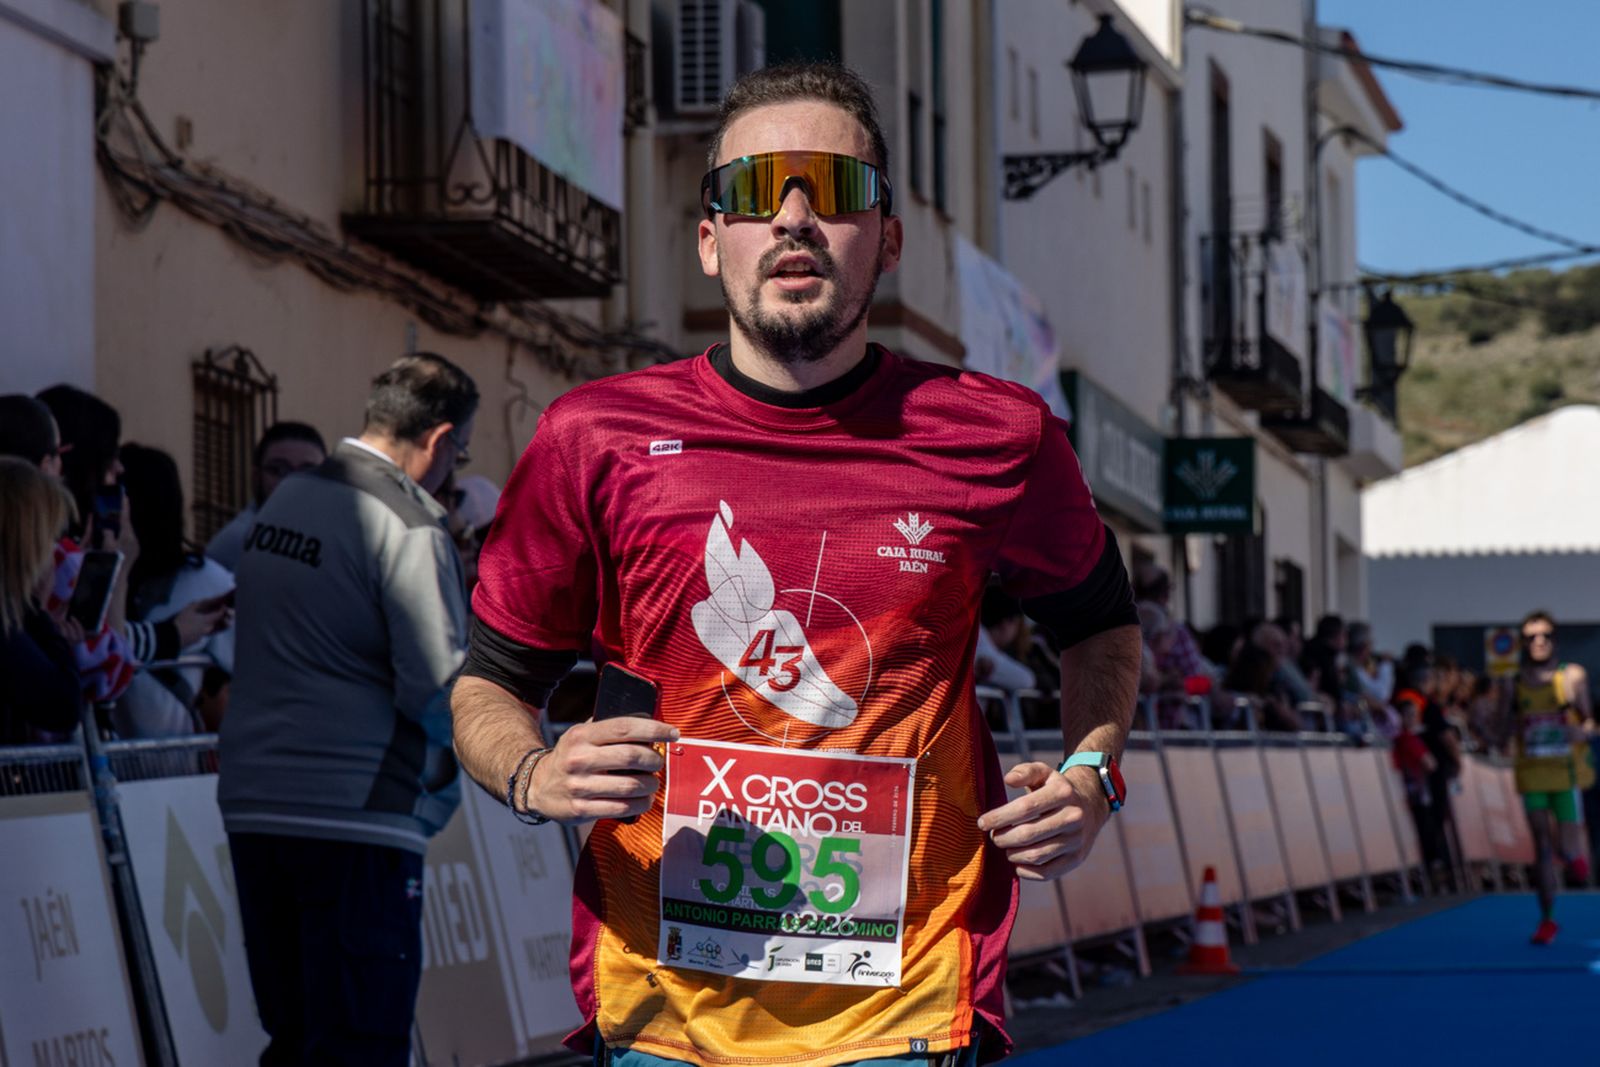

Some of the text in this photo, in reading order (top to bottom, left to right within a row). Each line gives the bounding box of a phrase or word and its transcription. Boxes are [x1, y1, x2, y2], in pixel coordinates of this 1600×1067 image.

[909, 547, 946, 564] RURAL
[738, 629, 805, 692] 43
[700, 755, 868, 813] X CROSS
[697, 800, 866, 838] PANTANO DEL
[700, 825, 861, 915] 595
[21, 886, 79, 981] JAÉN
[663, 900, 728, 924] ANTONIO
[731, 911, 800, 932] PARRAS
